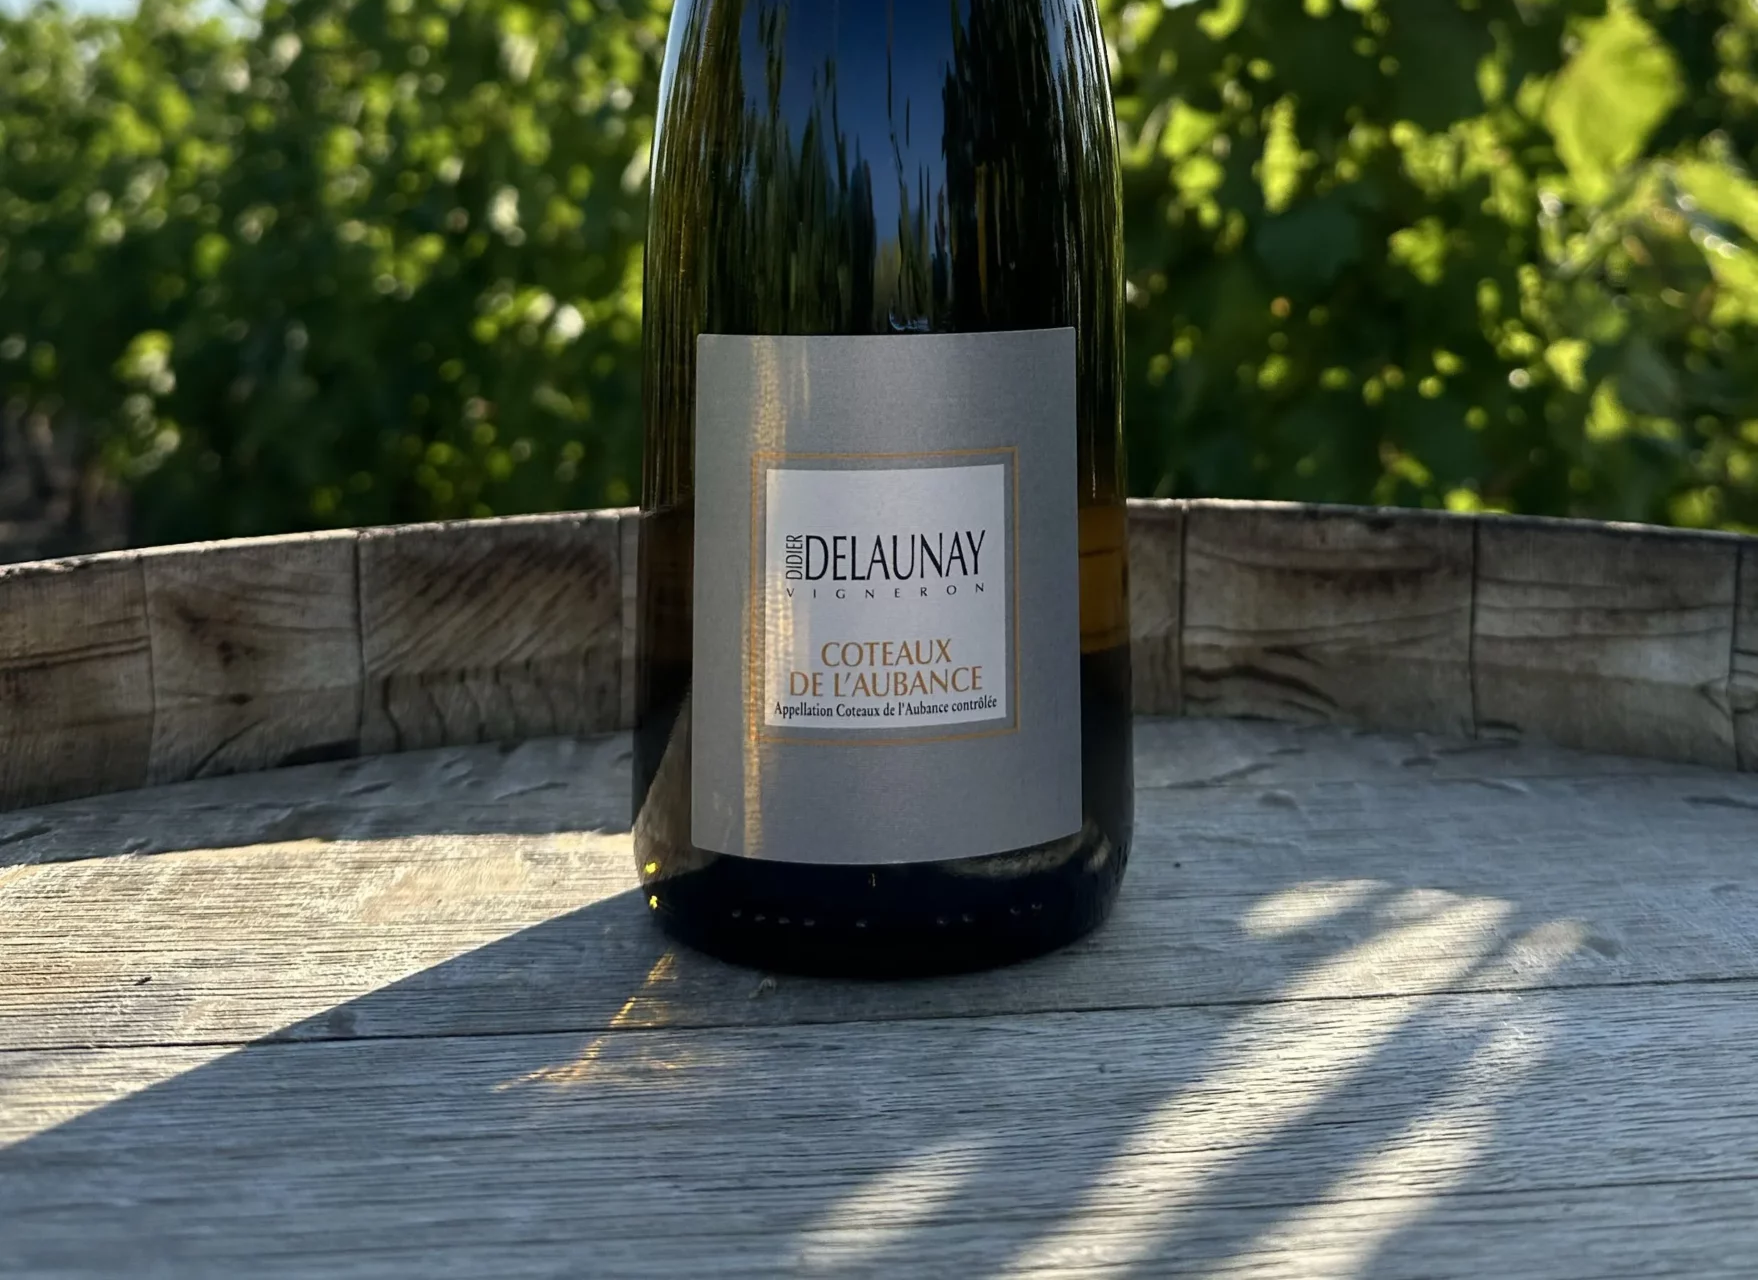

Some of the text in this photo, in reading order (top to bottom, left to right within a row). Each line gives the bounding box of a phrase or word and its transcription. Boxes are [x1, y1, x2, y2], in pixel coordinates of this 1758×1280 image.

[786, 534, 803, 580] DIDIER
[805, 530, 986, 581] DELAUNAY
[787, 583, 984, 599] VIGNERON
[821, 639, 952, 667] COTEAUX
[790, 666, 983, 697] DE L'AUBANCE
[774, 695, 998, 719] Appellation Coteaux de l'Aubance contrôlée
